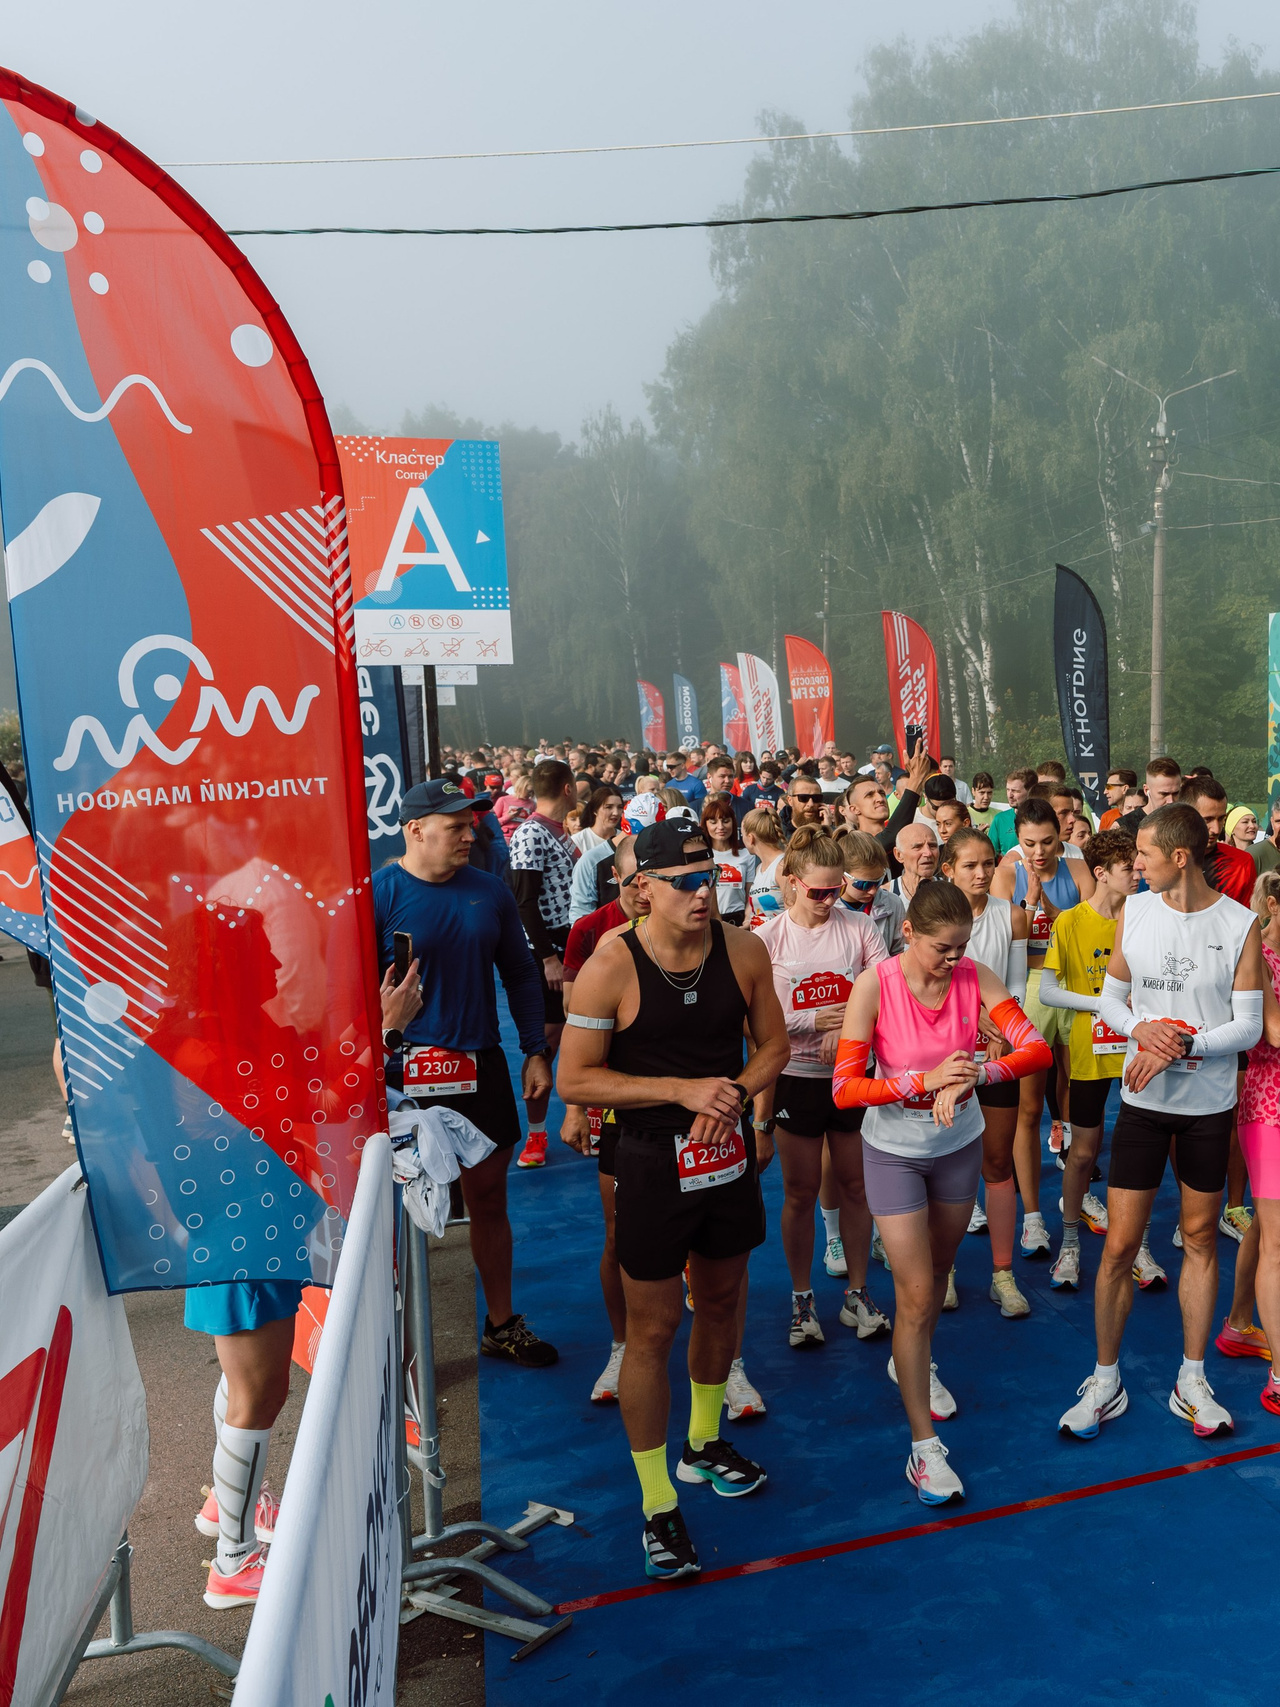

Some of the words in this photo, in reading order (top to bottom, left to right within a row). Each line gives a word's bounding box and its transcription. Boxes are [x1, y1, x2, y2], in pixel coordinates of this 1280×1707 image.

[375, 450, 445, 468] Кластер
[395, 469, 428, 480] Corral
[375, 487, 472, 592] A
[1041, 922, 1053, 934] 20
[808, 984, 840, 1001] 2071
[1142, 978, 1165, 991] ЖИВЕЙ
[1166, 981, 1184, 993] БЕГИ!
[975, 1033, 990, 1044] 28
[422, 1060, 460, 1076] 2307
[697, 1140, 737, 1165] 2264
